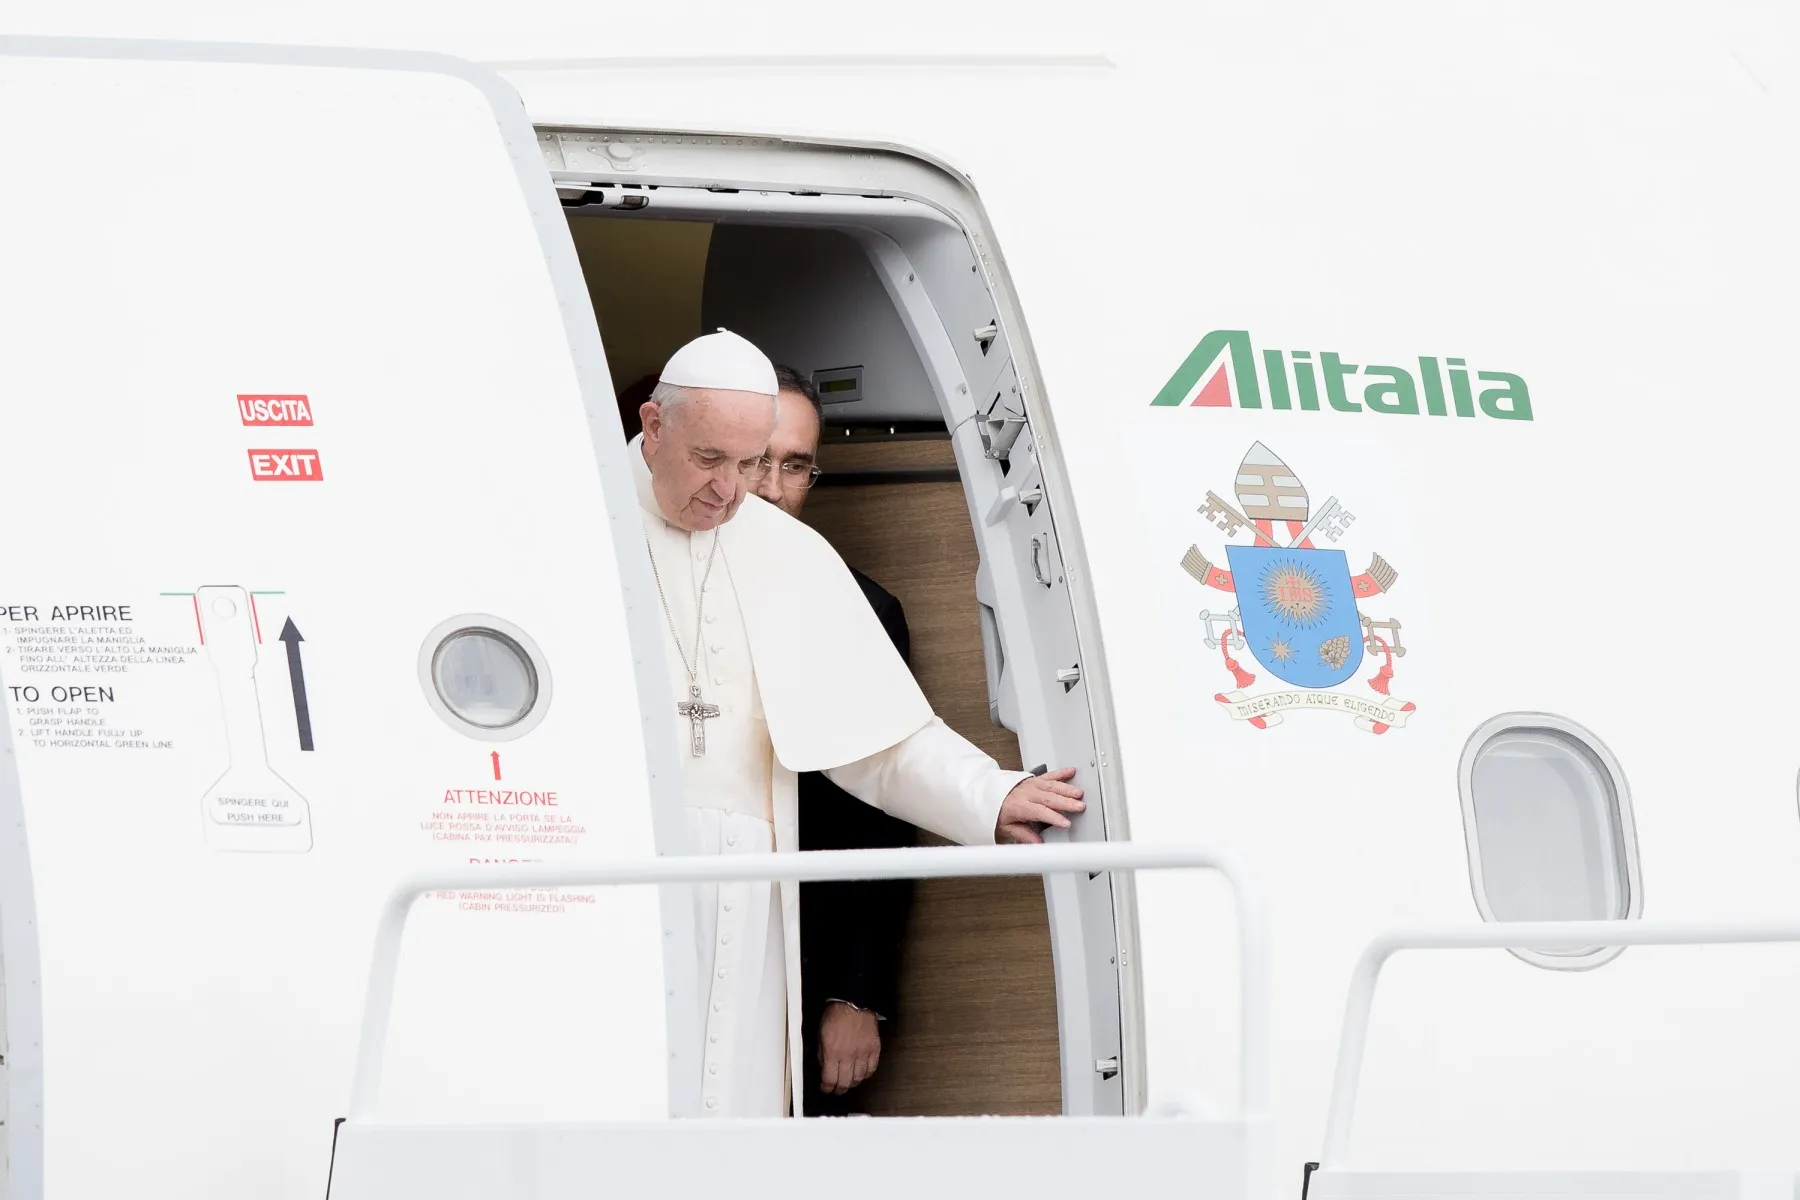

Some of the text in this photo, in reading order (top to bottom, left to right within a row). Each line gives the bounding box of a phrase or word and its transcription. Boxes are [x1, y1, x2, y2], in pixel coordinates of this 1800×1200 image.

[1149, 330, 1534, 421] Alitalia
[239, 399, 312, 422] USCITA
[251, 454, 316, 476] EXIT
[51, 605, 133, 622] APRIRE
[15, 627, 66, 635] SPINGERE
[119, 627, 132, 635] ED
[17, 636, 146, 645] IMPUGNARE LA MANIGLIA
[133, 646, 146, 654] LA
[149, 646, 198, 655] MANIGLIA
[20, 655, 44, 663] FINO
[73, 655, 118, 663] ALTEZZA
[120, 655, 153, 663] DELLA
[156, 656, 185, 664] LINEA
[21, 664, 128, 673] ORIZZONTALE VERDE
[9, 686, 115, 703] TO OPEN
[27, 707, 54, 716] PUSH
[57, 708, 82, 716] FLAP
[87, 708, 100, 716] TO
[1237, 694, 1300, 717] MISERANDO
[1344, 699, 1396, 723] ELIGENDO
[29, 718, 106, 727] GRASP HANDLE
[30, 729, 51, 737] LIFT
[55, 729, 94, 737] HANDLE
[98, 729, 126, 738] FULLY
[130, 730, 143, 738] UP
[33, 739, 174, 750] TO HORIZONTAL GREEN LINE
[218, 797, 289, 809] SPINGERE QUI
[444, 790, 558, 806] ATTENZIONE
[226, 812, 285, 823] PUSH HERE
[432, 812, 573, 824] NON APRIRE LA PORTA SE LA
[420, 821, 446, 831] LUCE
[449, 822, 482, 832] ROSSA
[532, 825, 587, 835] LAMPEGGIA
[474, 833, 493, 842] PAX
[436, 890, 456, 900] RED
[459, 891, 503, 901] WARNING
[506, 892, 532, 902] LIGHT
[536, 893, 546, 902] IS
[549, 894, 596, 904] FLASHING
